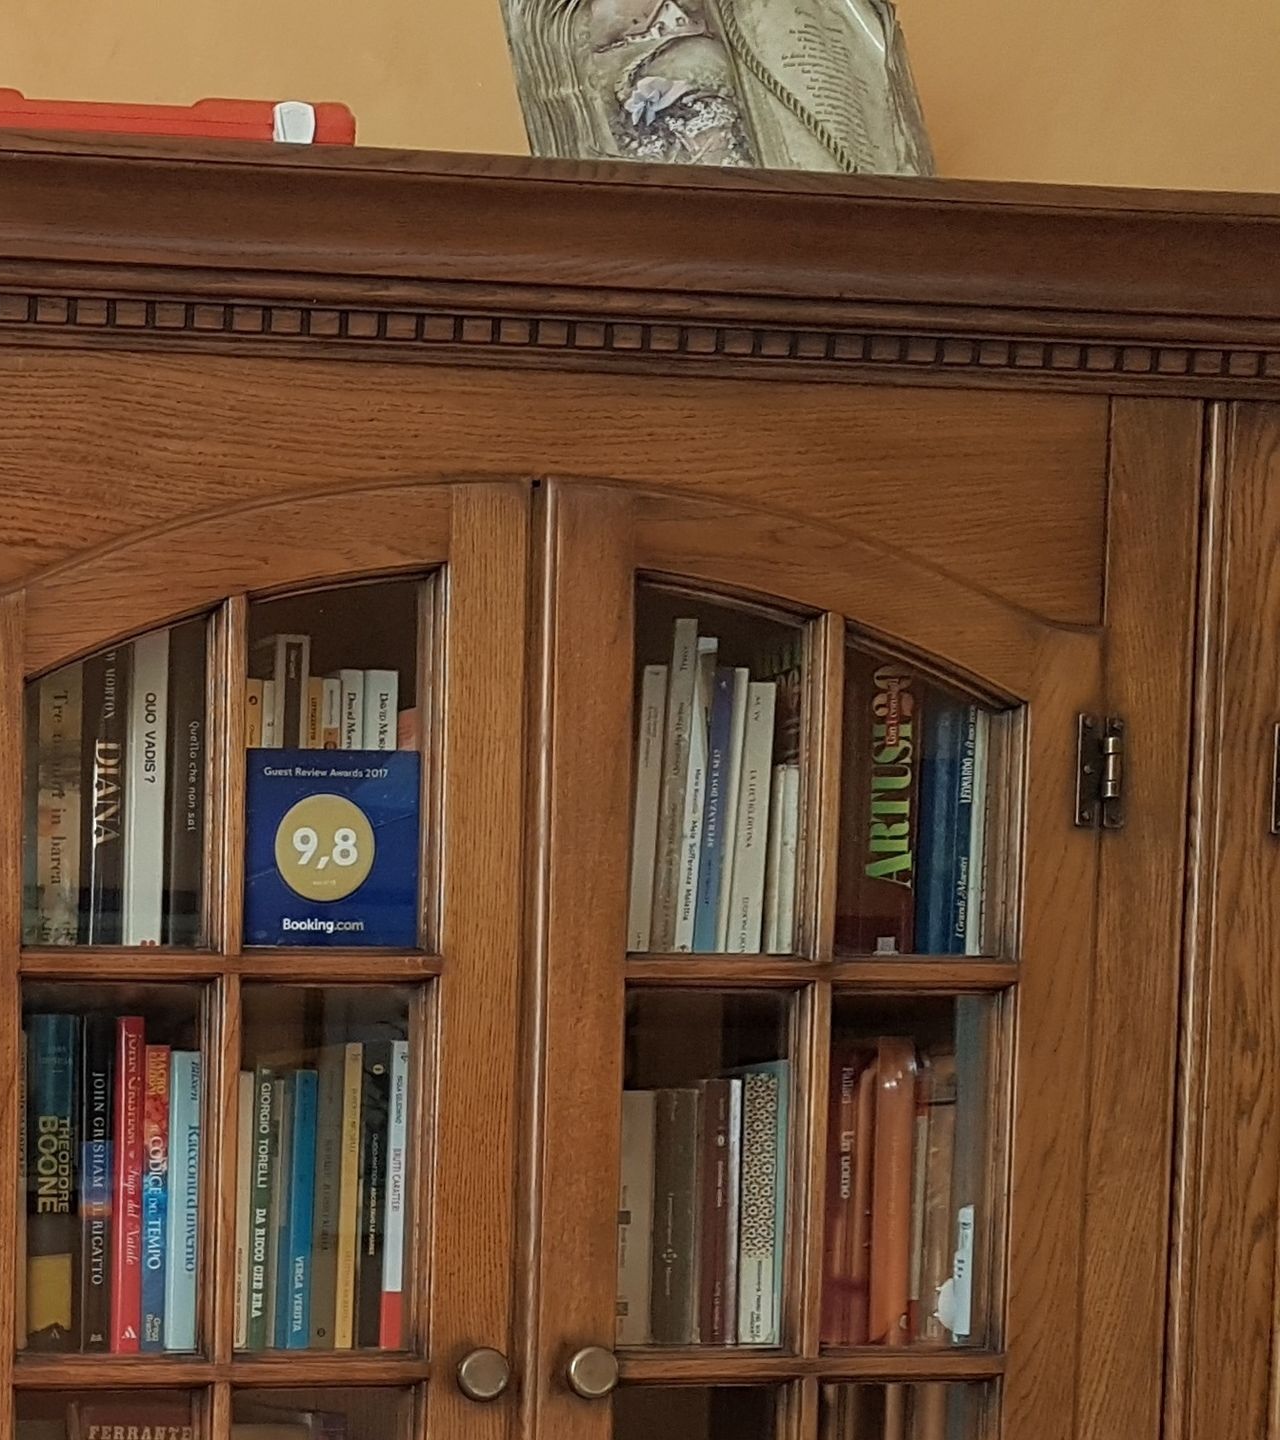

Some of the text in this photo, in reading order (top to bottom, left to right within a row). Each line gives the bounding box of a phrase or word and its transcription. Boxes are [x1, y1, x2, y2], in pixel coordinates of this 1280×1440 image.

[52, 691, 68, 723] Tre
[104, 669, 115, 719] MORTON
[145, 693, 156, 723] QUO
[145, 731, 155, 772] VADIS
[187, 721, 199, 831] Quello che non sai
[264, 767, 388, 778] Guest Review Awards 2017
[93, 740, 121, 849] DIANA
[864, 722, 913, 888] ARTUSI
[960, 758, 974, 803] LEONARDO
[52, 809, 66, 825] in
[52, 837, 67, 884] barca
[293, 827, 358, 869] 9,8
[283, 918, 363, 933] Booking.com
[841, 1067, 854, 1104] Fallaci
[92, 1073, 105, 1188] JOHN GRISHAM
[257, 1083, 271, 1188] GIORGIO TORELLI
[37, 1116, 58, 1213] BOONE
[58, 1117, 70, 1213] THEODORE
[148, 1136, 163, 1195] CODICE
[391, 1148, 401, 1212] BRUTTI CARATTERI
[840, 1131, 854, 1199] Un uomo
[126, 1200, 139, 1217] dal
[92, 1221, 103, 1285] RICATTO
[125, 1223, 140, 1265] Natale
[147, 1219, 162, 1269] TEMPO
[251, 1209, 266, 1317] DA RICCO CHE ERA
[292, 1256, 305, 1332] VERGA VERISTA
[89, 1425, 192, 1440] FERRANTE
